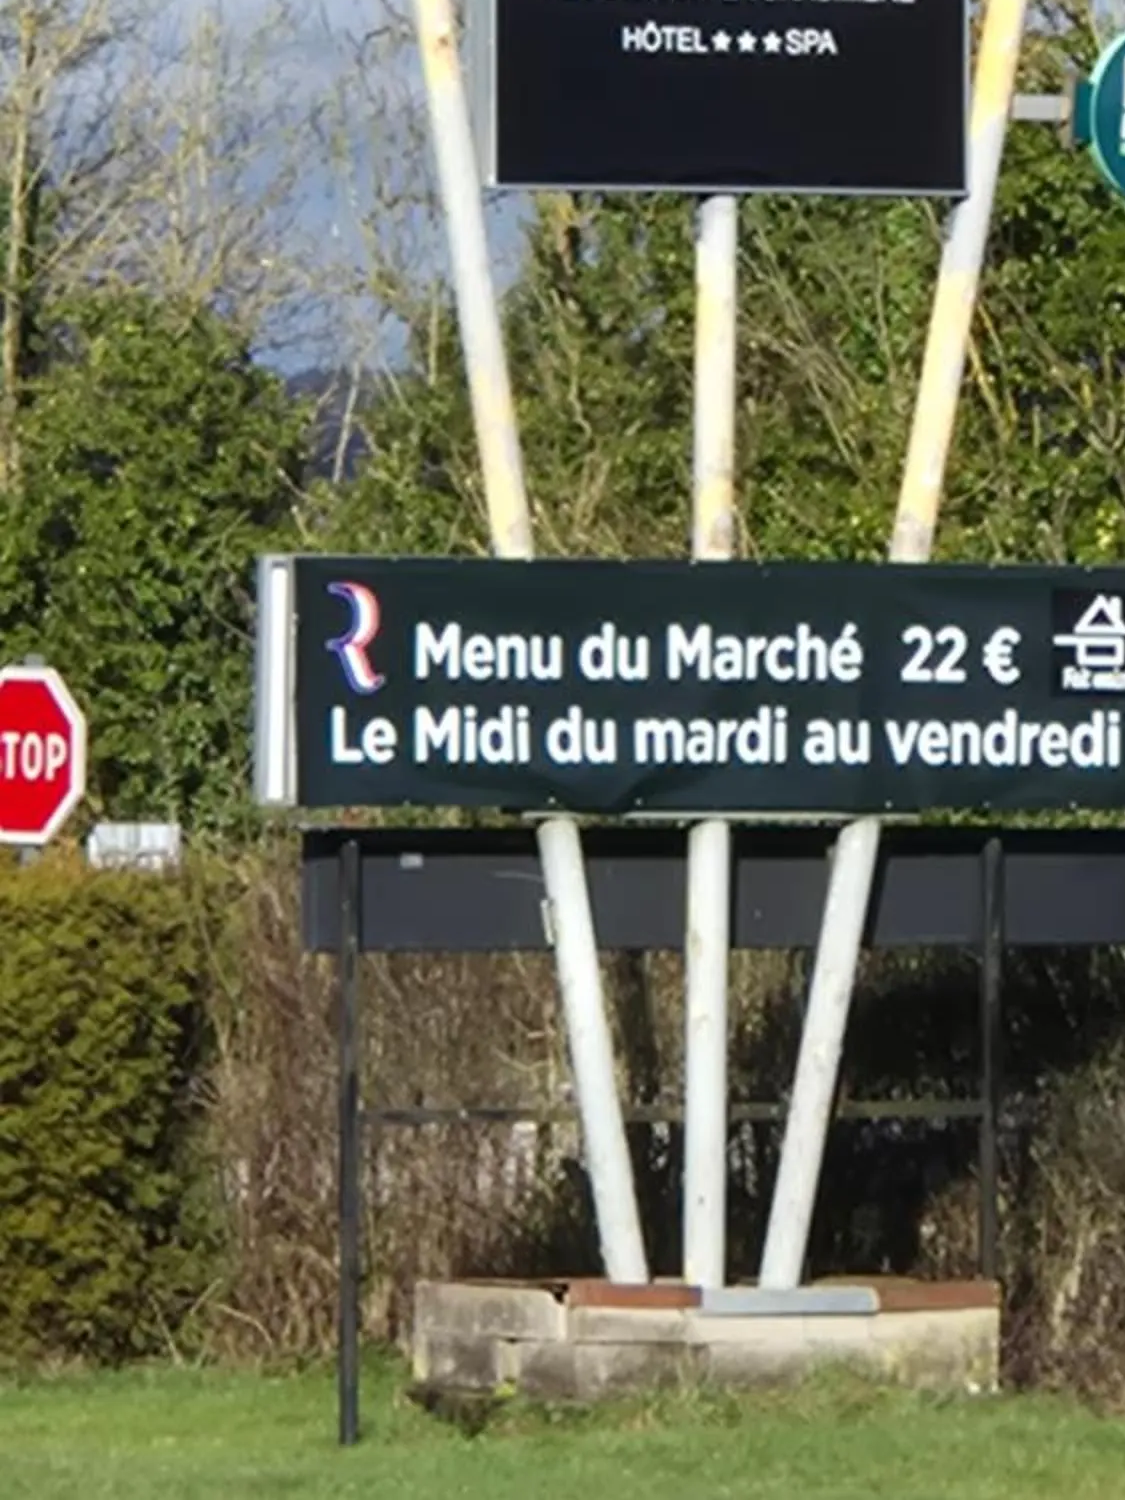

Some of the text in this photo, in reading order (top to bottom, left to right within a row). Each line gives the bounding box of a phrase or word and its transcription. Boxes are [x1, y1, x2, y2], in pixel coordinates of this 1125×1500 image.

[622, 21, 838, 55] HÔTEL SPA
[415, 622, 563, 680] Menu
[579, 622, 649, 681] du
[667, 622, 863, 682] Marché
[900, 625, 967, 683] 22
[982, 626, 1021, 684] €
[0, 731, 68, 781] TOP
[332, 705, 1121, 767] Le Midi du mardi au vendredi
